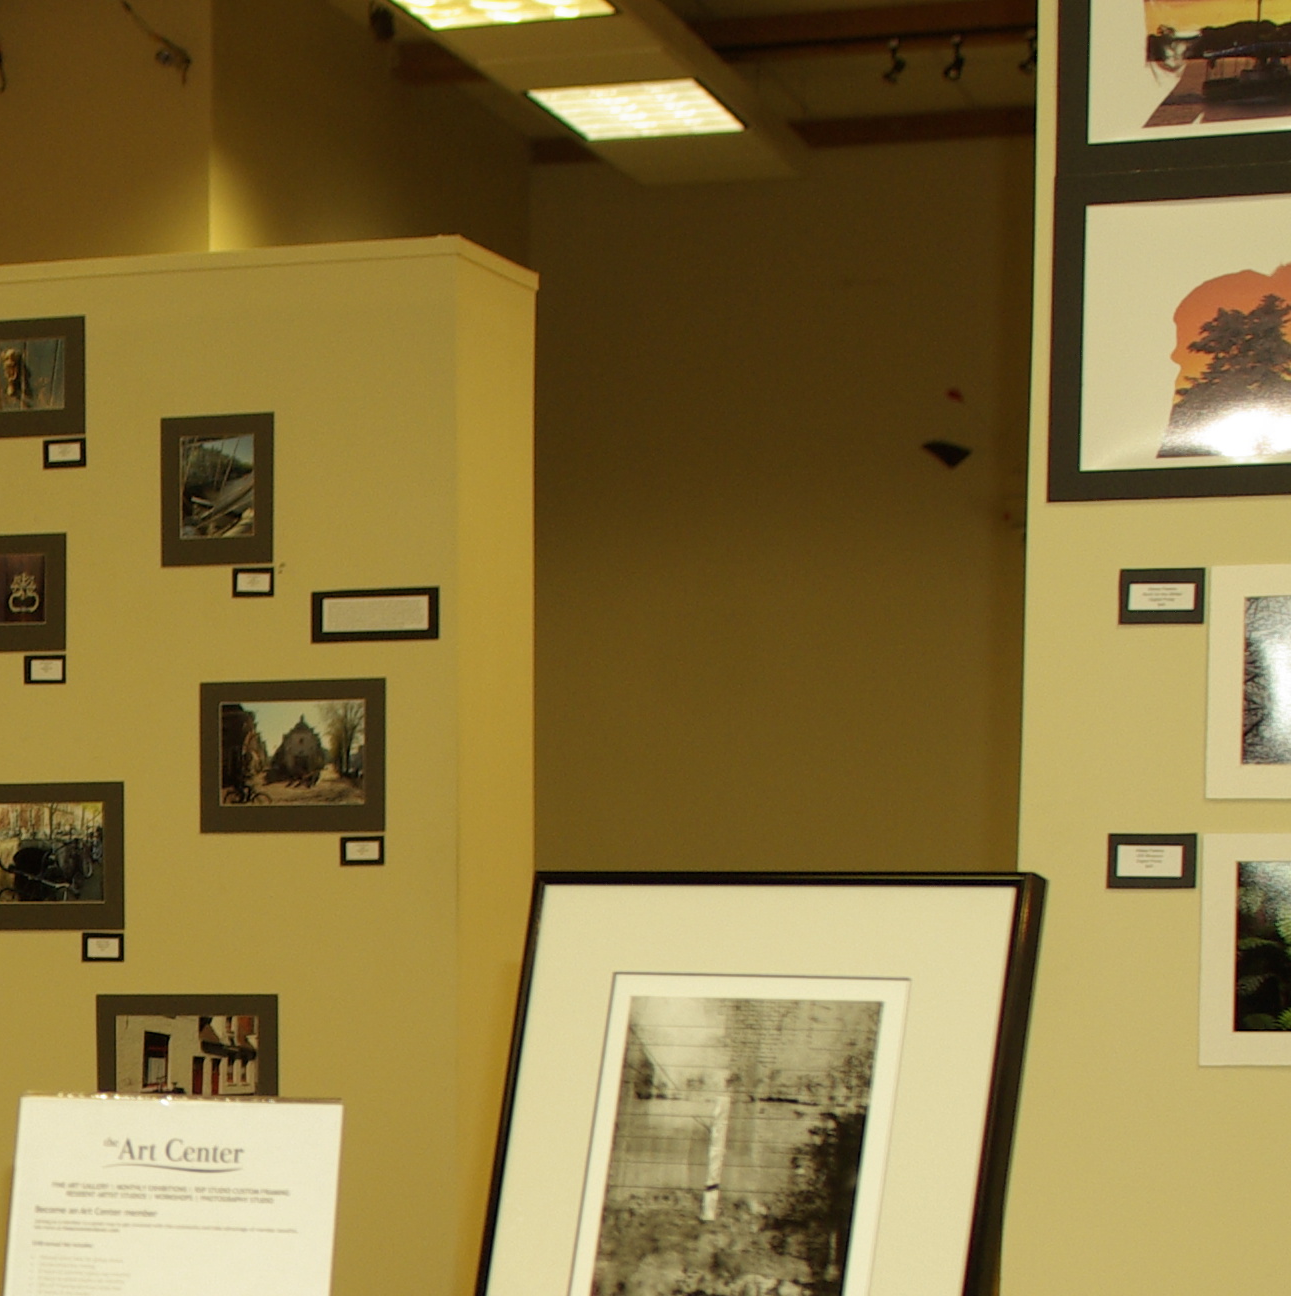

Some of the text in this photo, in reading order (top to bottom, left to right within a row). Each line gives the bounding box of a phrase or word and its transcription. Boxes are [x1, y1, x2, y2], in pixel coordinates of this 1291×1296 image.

[103, 1136, 245, 1164] the Art Center
